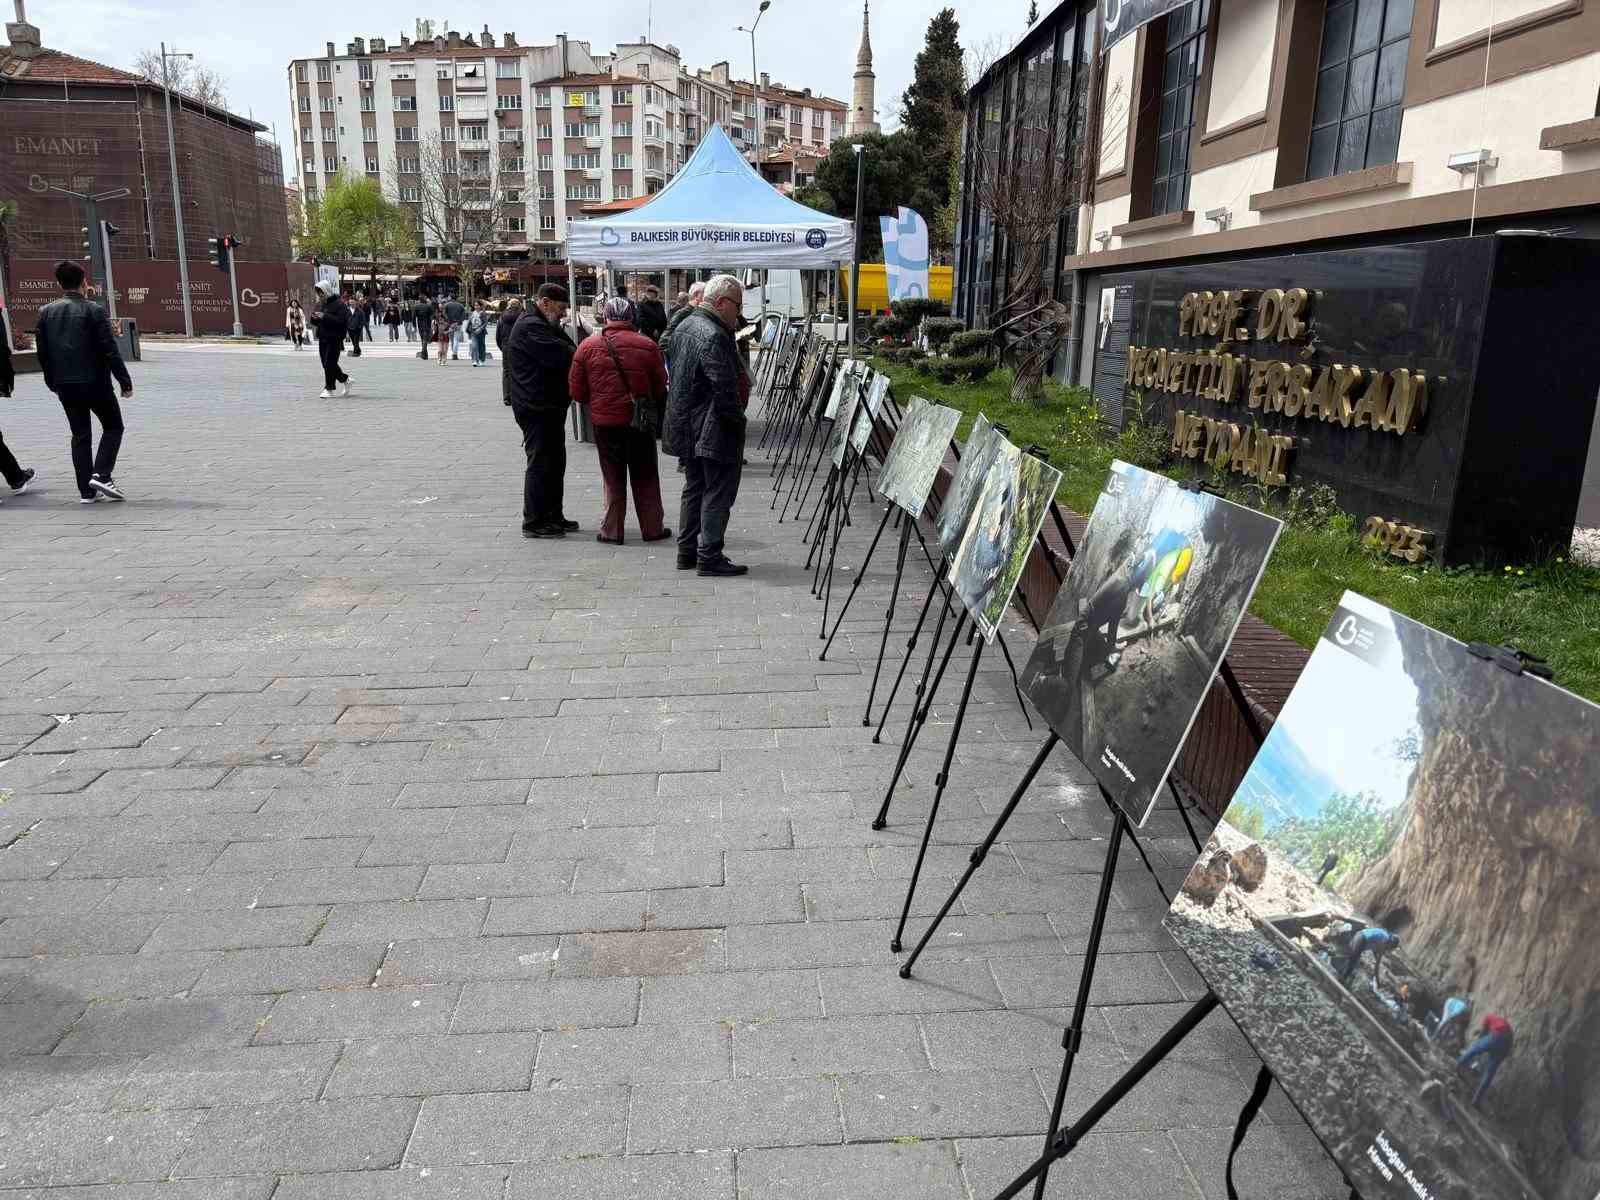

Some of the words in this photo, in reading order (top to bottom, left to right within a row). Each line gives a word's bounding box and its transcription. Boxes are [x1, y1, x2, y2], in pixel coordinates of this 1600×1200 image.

[16, 136, 104, 156] EMANET
[631, 229, 679, 242] BALIKESİR
[681, 228, 741, 244] BÜYÜKŞEHİR
[743, 230, 796, 243] BELEDİYESİ
[19, 281, 56, 289] EMANET
[177, 282, 212, 291] EANET
[1178, 288, 1250, 342] PROF.
[1126, 343, 1244, 403] NECMETTİN
[1248, 358, 1427, 436] ERBAKAN
[1171, 409, 1293, 486] MEYDANI
[1366, 1145, 1393, 1182] Havran
